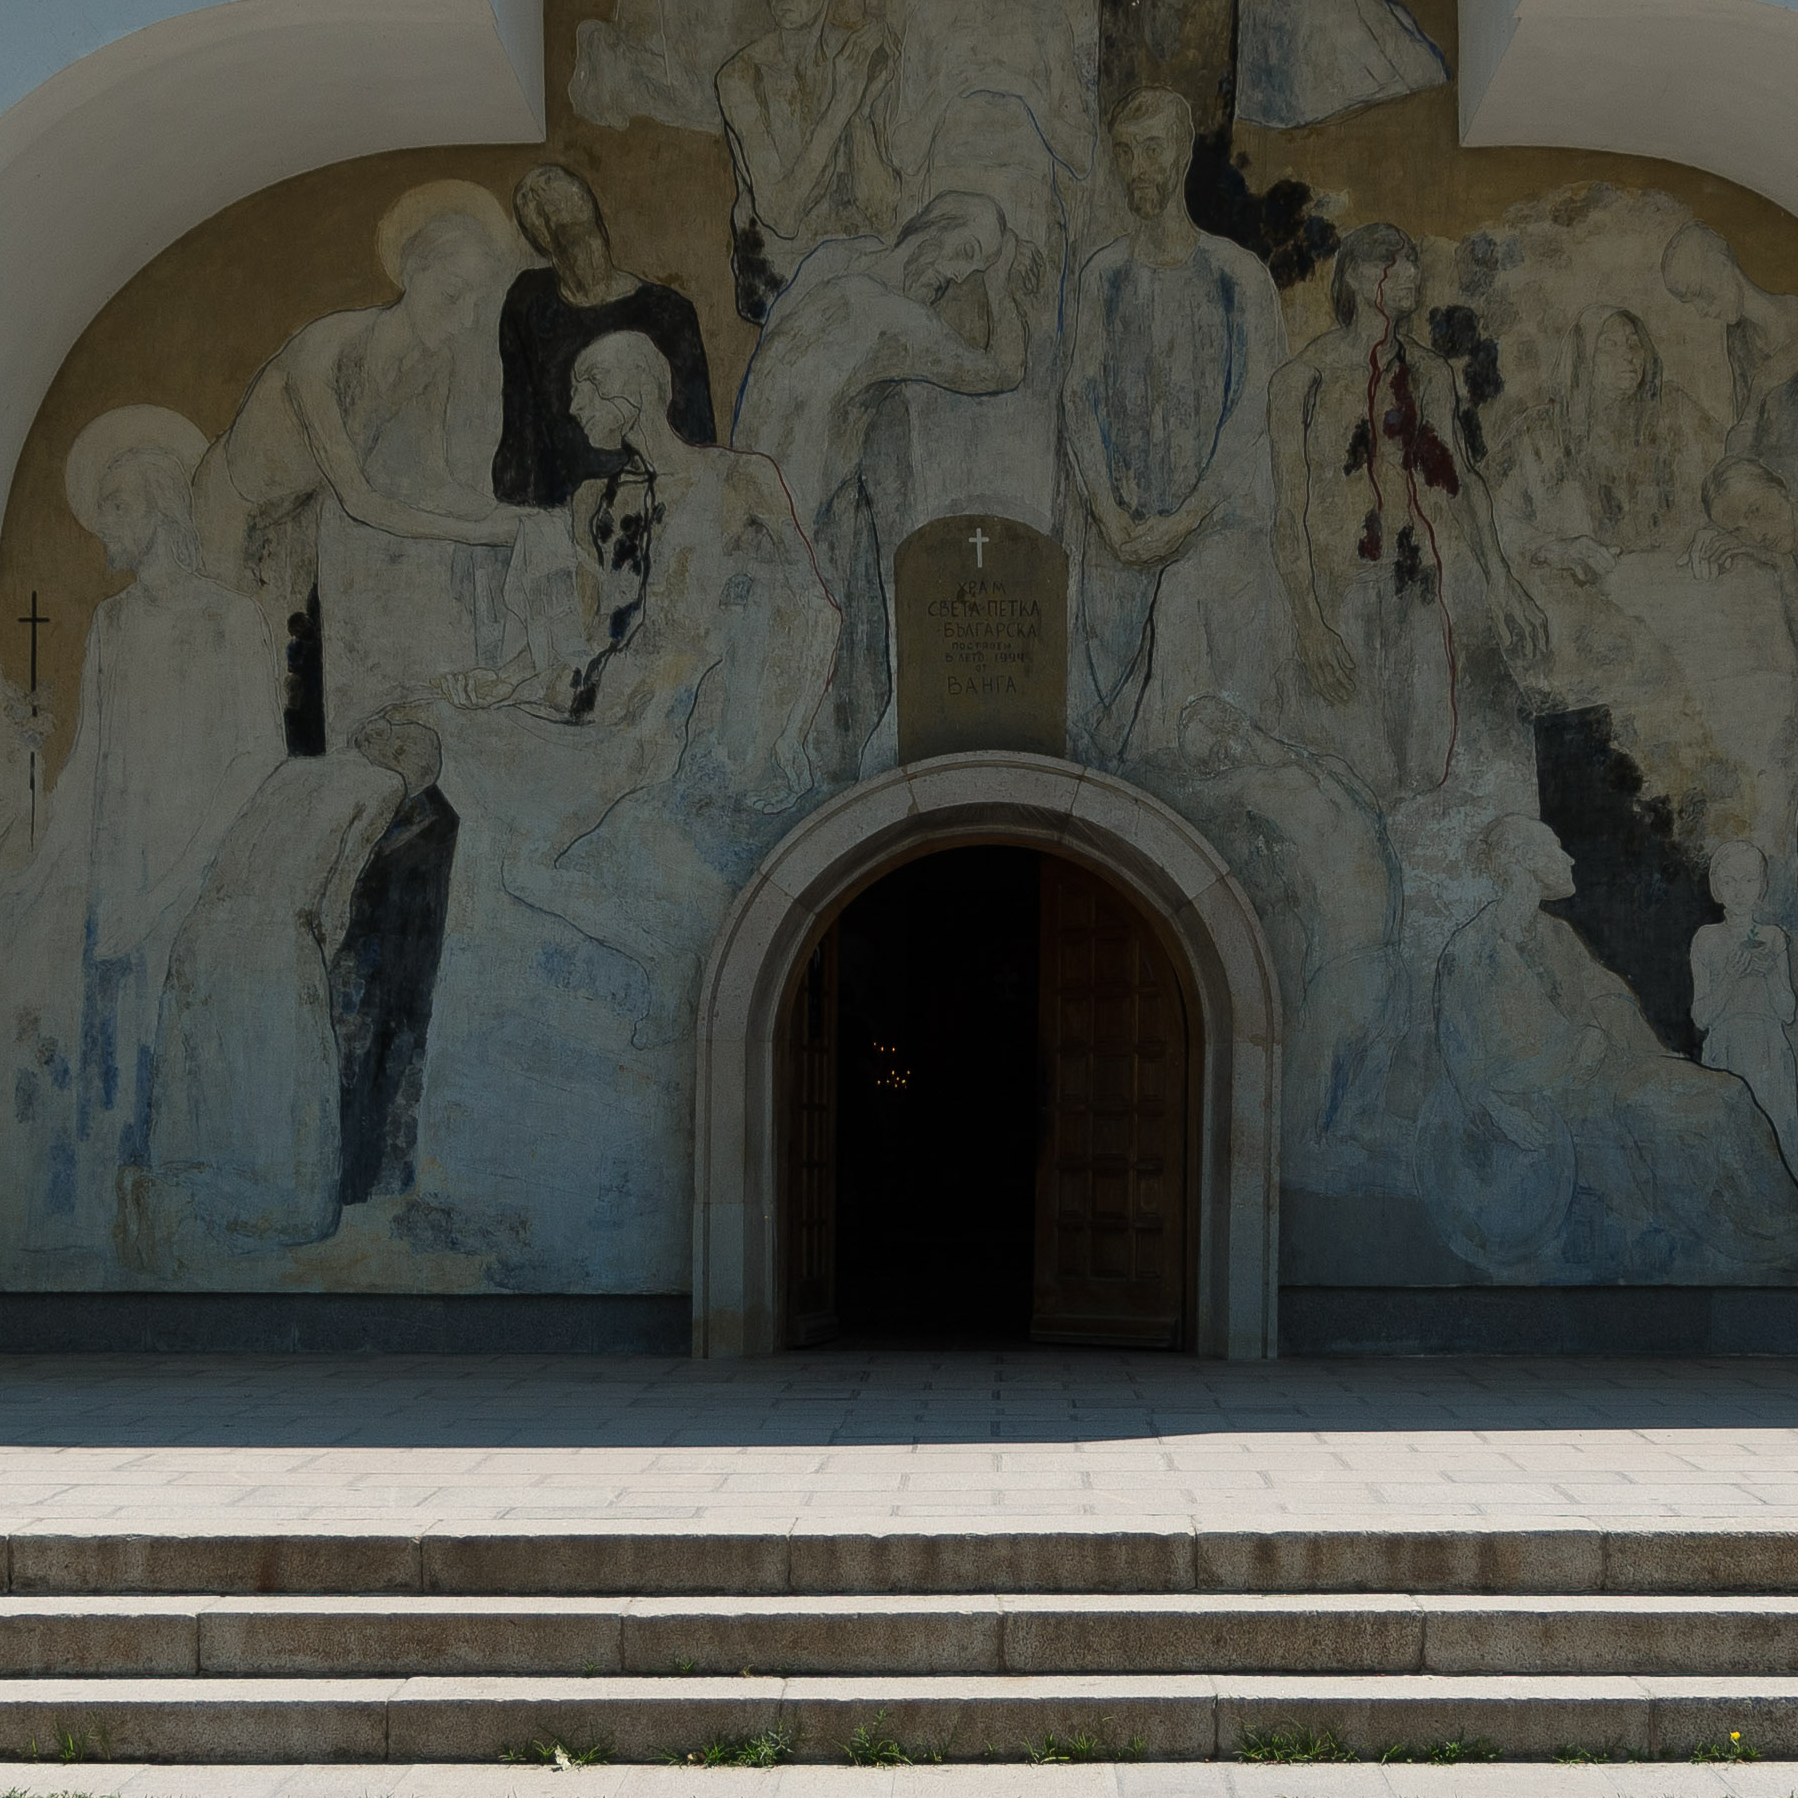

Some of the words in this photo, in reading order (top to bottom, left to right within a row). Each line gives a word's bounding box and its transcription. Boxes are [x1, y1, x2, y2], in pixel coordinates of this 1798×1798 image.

[928, 600, 981, 617] СВЕТА
[987, 600, 1040, 617] ПЕТКА
[994, 652, 1025, 663] 1994
[947, 675, 1017, 695] ВАНГА
